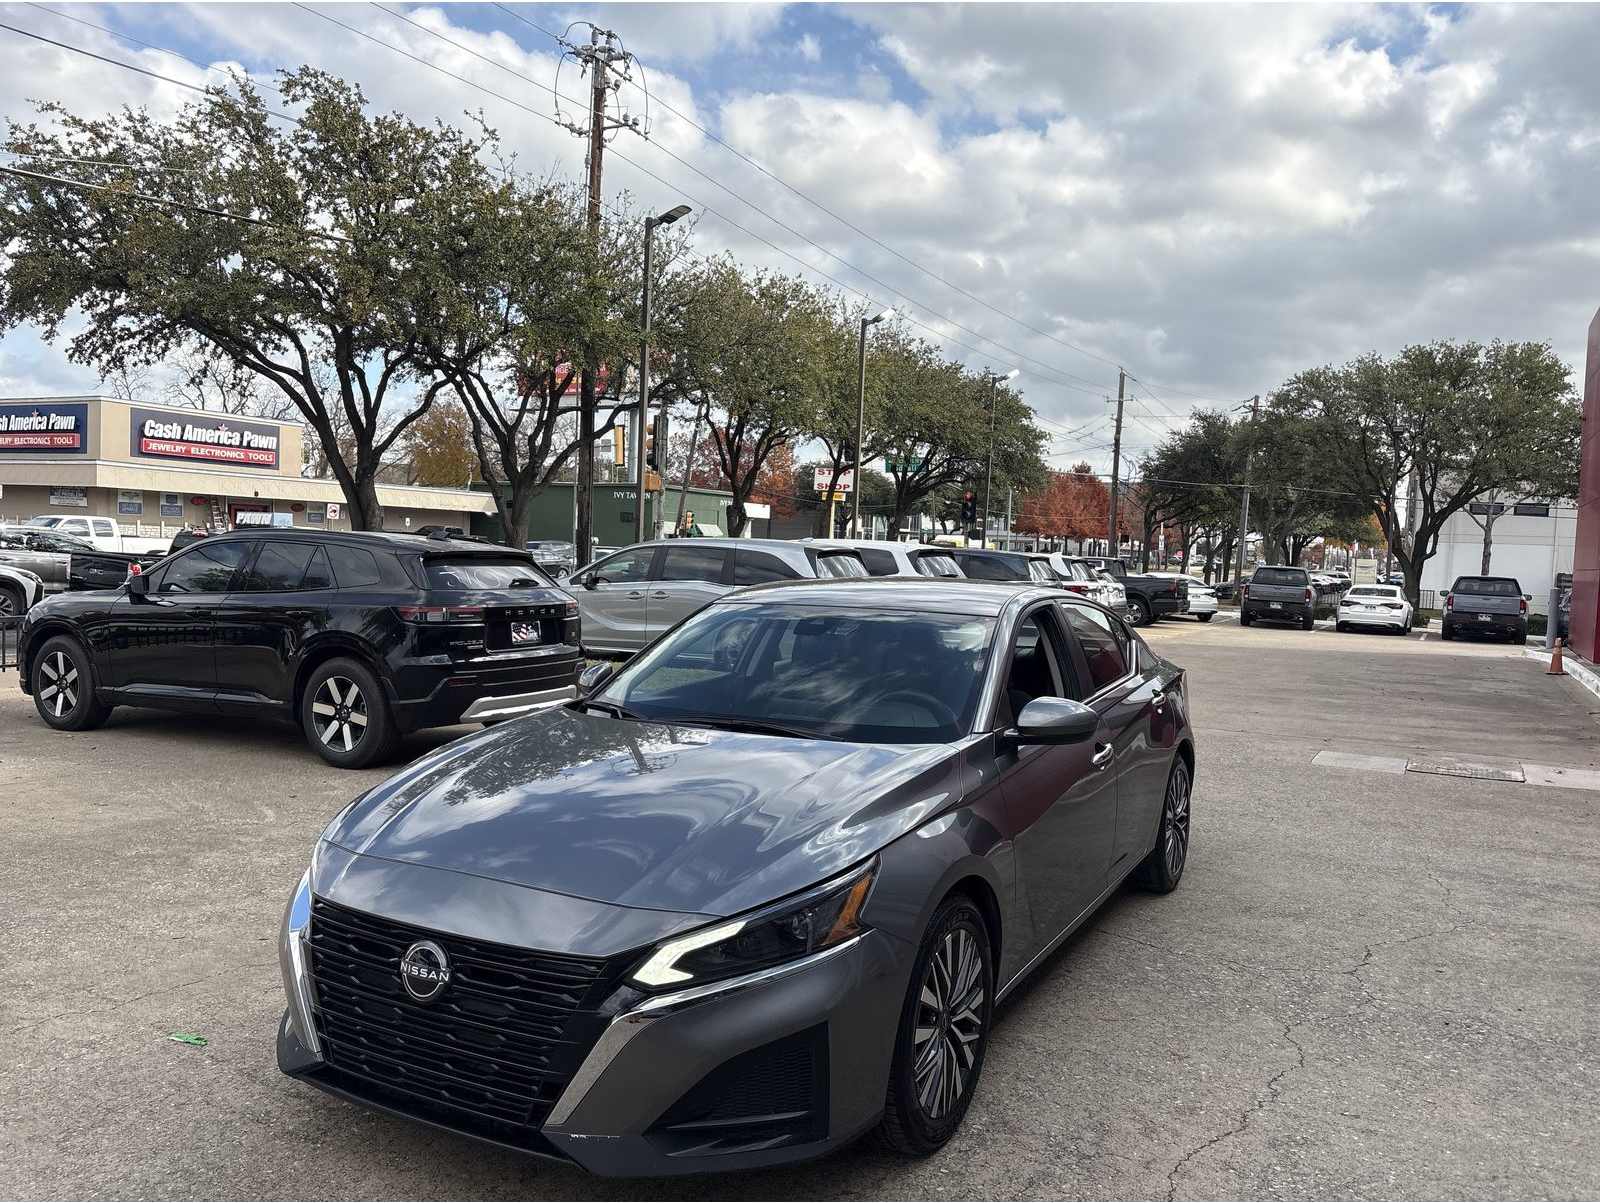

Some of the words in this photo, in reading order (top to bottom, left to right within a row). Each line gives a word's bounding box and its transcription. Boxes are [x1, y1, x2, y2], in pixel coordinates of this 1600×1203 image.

[9, 414, 47, 431] America
[48, 413, 76, 430] Pawn
[54, 436, 73, 445] TOOLS
[144, 419, 182, 440] Cash
[183, 424, 241, 446] America
[242, 430, 278, 450] Pawn
[147, 442, 186, 453] JEWELRY
[190, 447, 245, 460] ELECTRONICS
[248, 452, 273, 462] TOOLS
[817, 468, 851, 476] STP
[235, 511, 273, 524] PAWN
[400, 961, 450, 982] NISSAN
